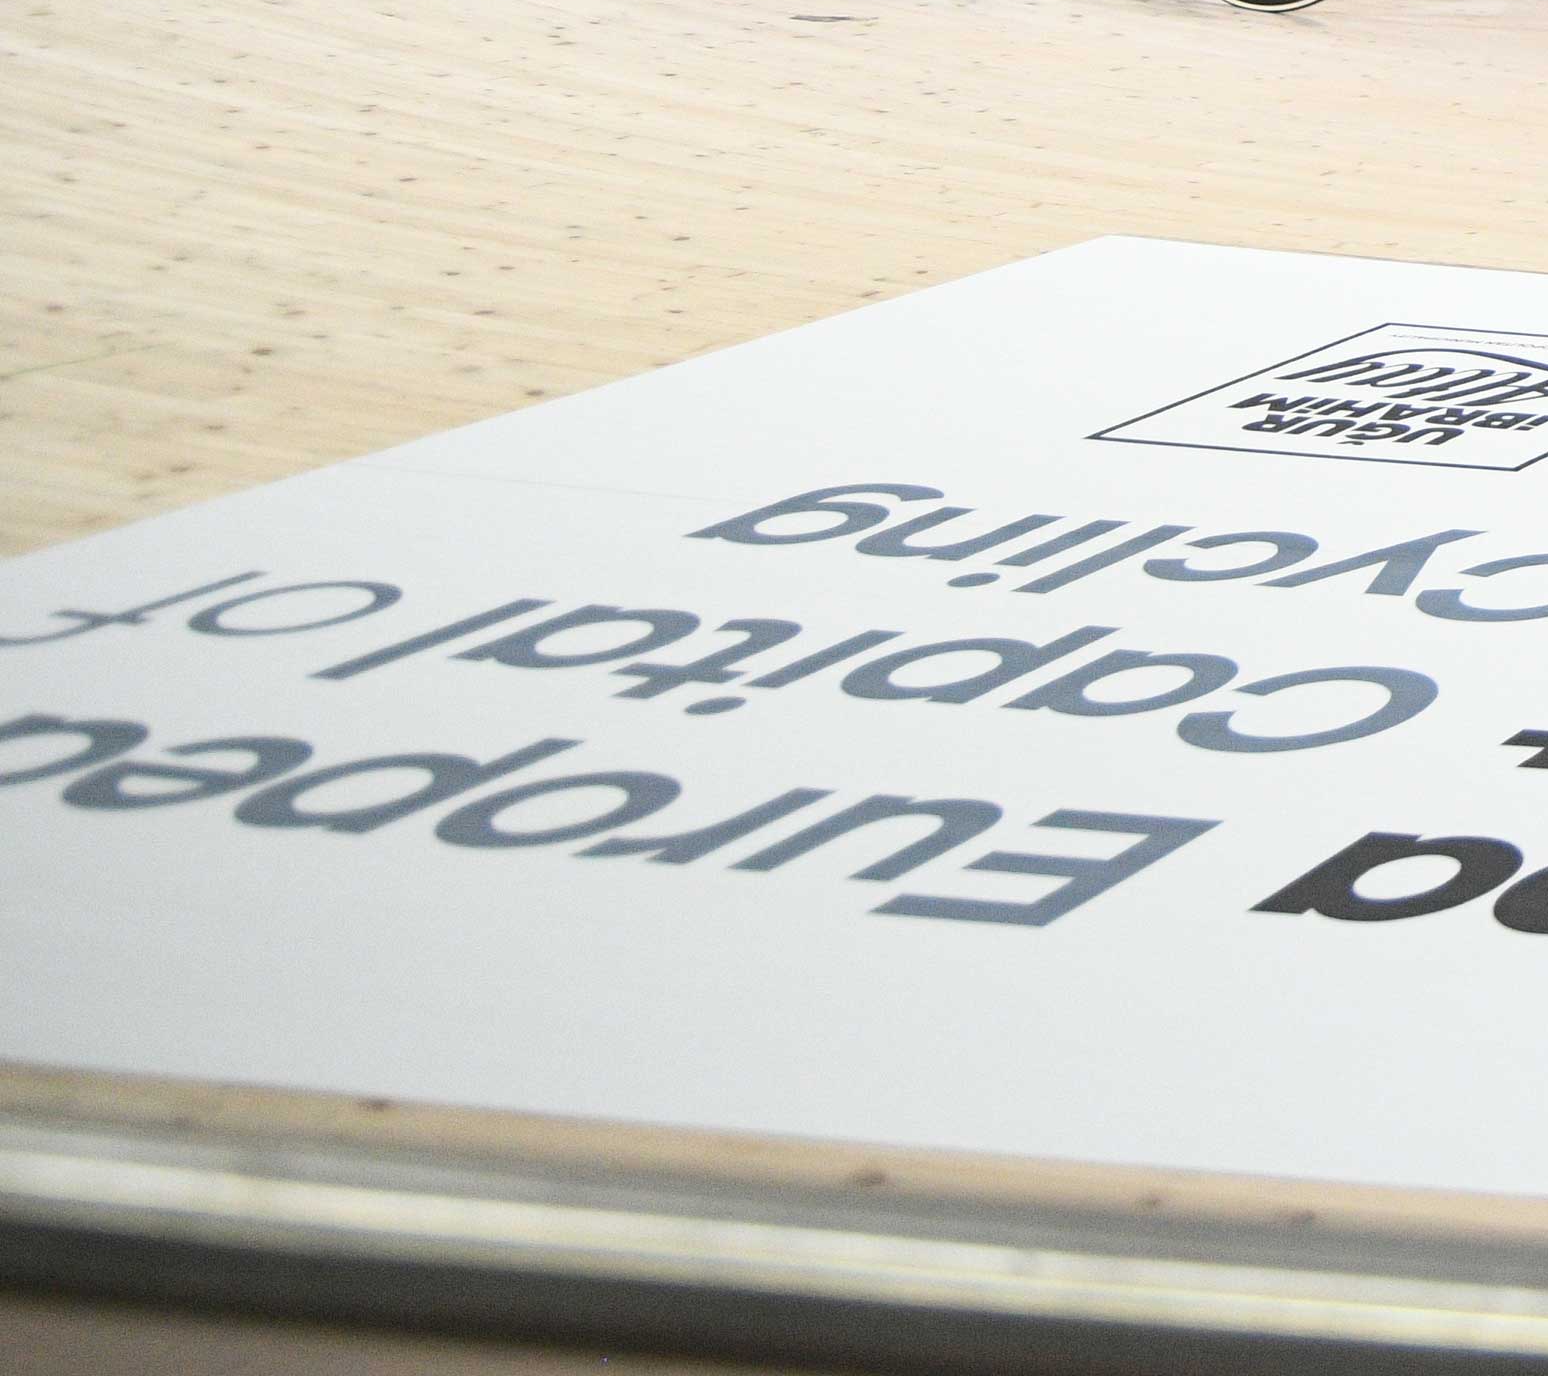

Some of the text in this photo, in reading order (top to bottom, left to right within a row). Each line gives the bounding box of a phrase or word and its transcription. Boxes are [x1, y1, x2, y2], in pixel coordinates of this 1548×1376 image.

[1241, 415, 1462, 448] UĞUR
[38, 568, 402, 646] of
[322, 603, 1439, 756] Capital
